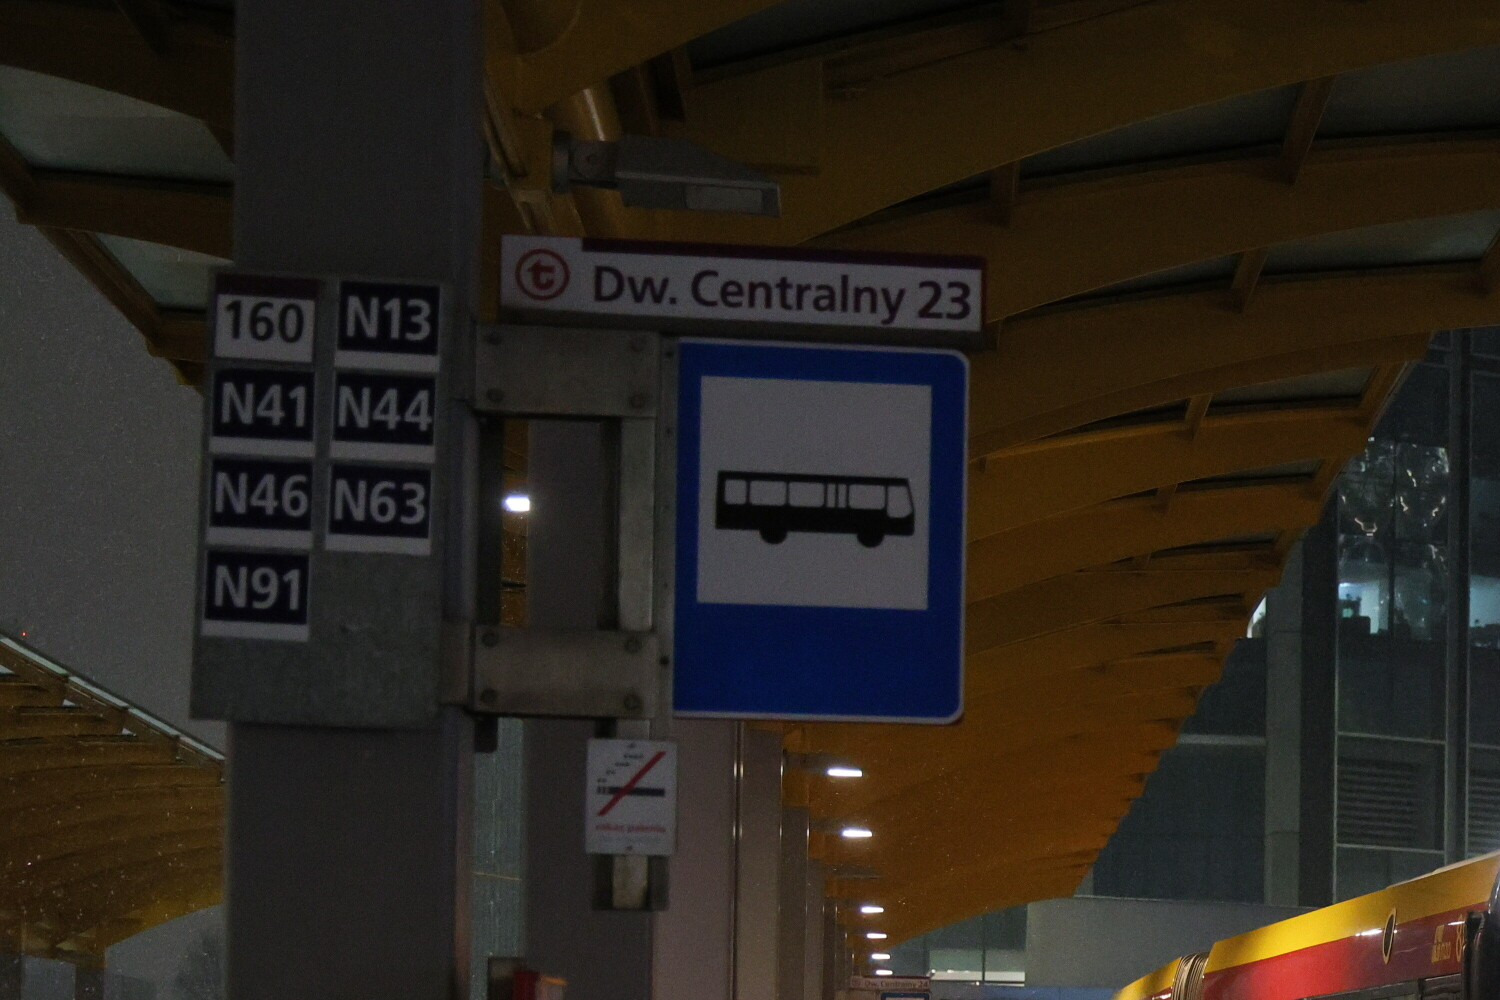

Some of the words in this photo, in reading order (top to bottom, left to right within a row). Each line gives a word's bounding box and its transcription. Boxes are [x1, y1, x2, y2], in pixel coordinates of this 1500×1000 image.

[345, 295, 432, 341] N13
[593, 265, 678, 306] Dw.
[690, 269, 907, 324] Centralny
[917, 280, 971, 320] 23
[223, 300, 305, 344] 160
[220, 381, 307, 428] N41
[336, 385, 432, 432] N44
[213, 471, 308, 518] N46
[332, 478, 427, 525] N63
[213, 564, 300, 611] N91
